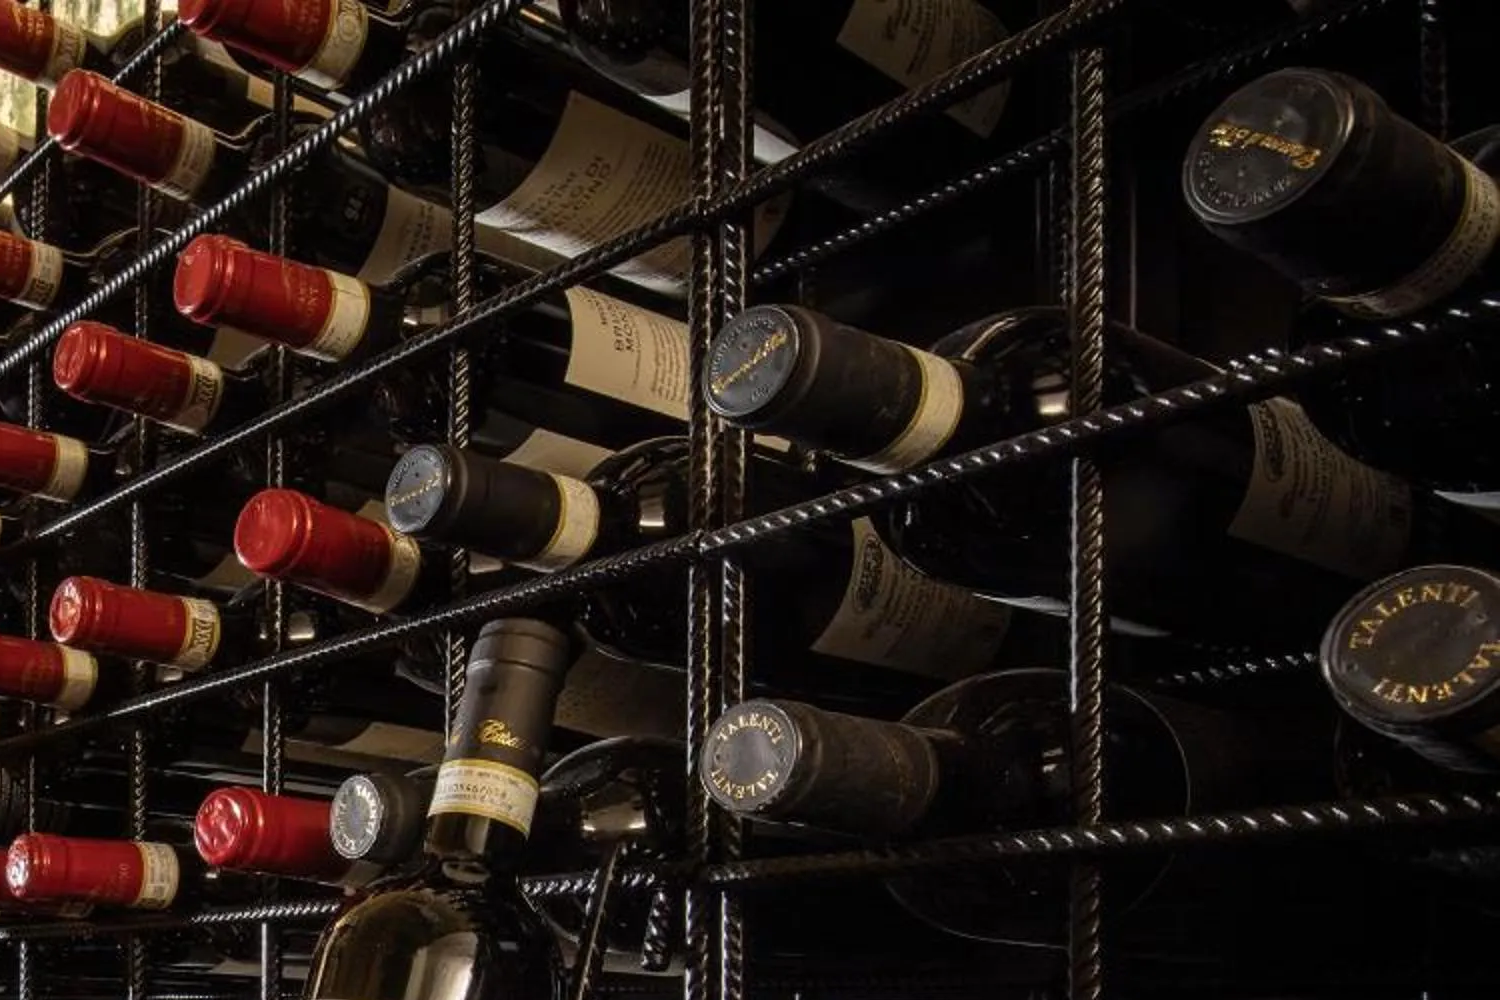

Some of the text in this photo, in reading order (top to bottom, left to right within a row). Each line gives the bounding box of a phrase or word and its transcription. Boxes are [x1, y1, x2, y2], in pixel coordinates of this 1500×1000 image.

[1349, 581, 1481, 649] TALENTI
[716, 711, 784, 745] TALENTI
[711, 768, 779, 800] TALENTI
